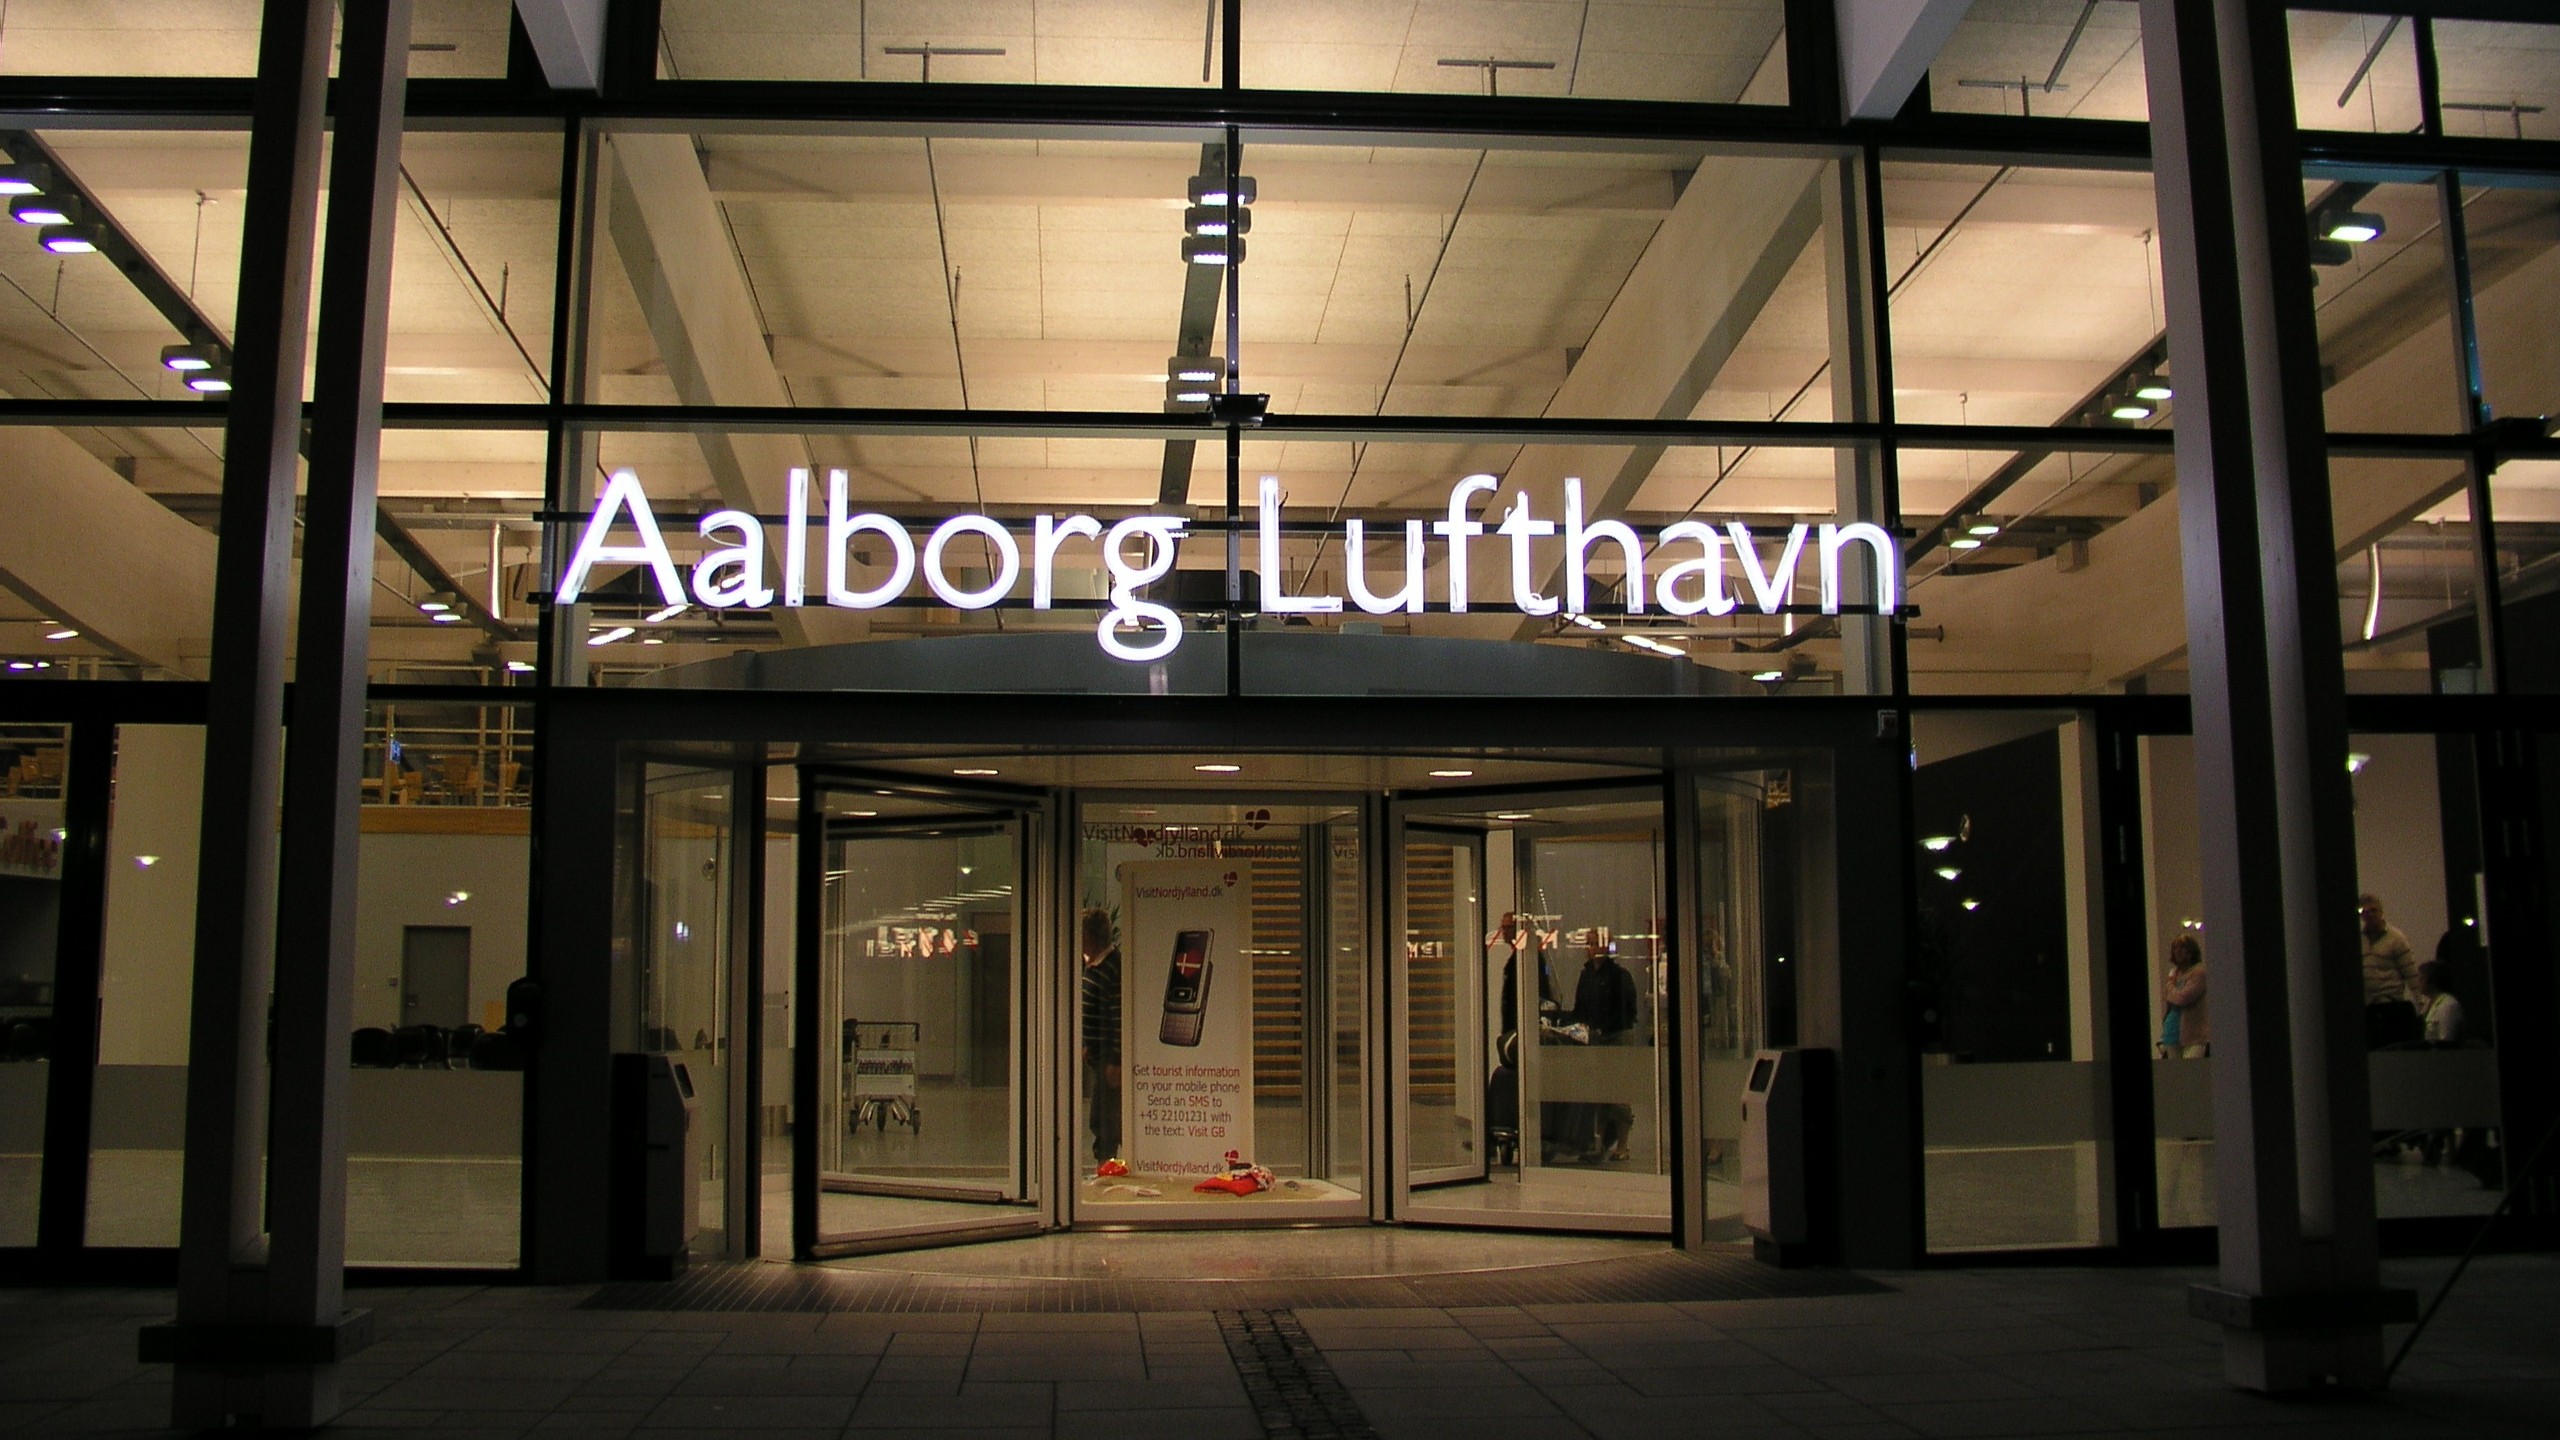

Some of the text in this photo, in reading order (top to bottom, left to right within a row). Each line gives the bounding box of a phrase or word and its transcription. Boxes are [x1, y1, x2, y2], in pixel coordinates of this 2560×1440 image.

[555, 467, 1900, 663] Aalborg Lufthavn
[1083, 823, 1246, 847] VisitNrdjylland.dk
[1136, 885, 1223, 901] VisitNordjylland.dk
[1133, 1064, 1240, 1077] Get tourist information
[1137, 1080, 1240, 1094] on your mobile phone
[1147, 1094, 1222, 1108] Send an SMS to
[1140, 1109, 1158, 1122] +45
[1211, 1111, 1231, 1123] with
[1145, 1124, 1225, 1137] the text: Visit GB
[1136, 1160, 1223, 1175] VisitNordjylland.dk
